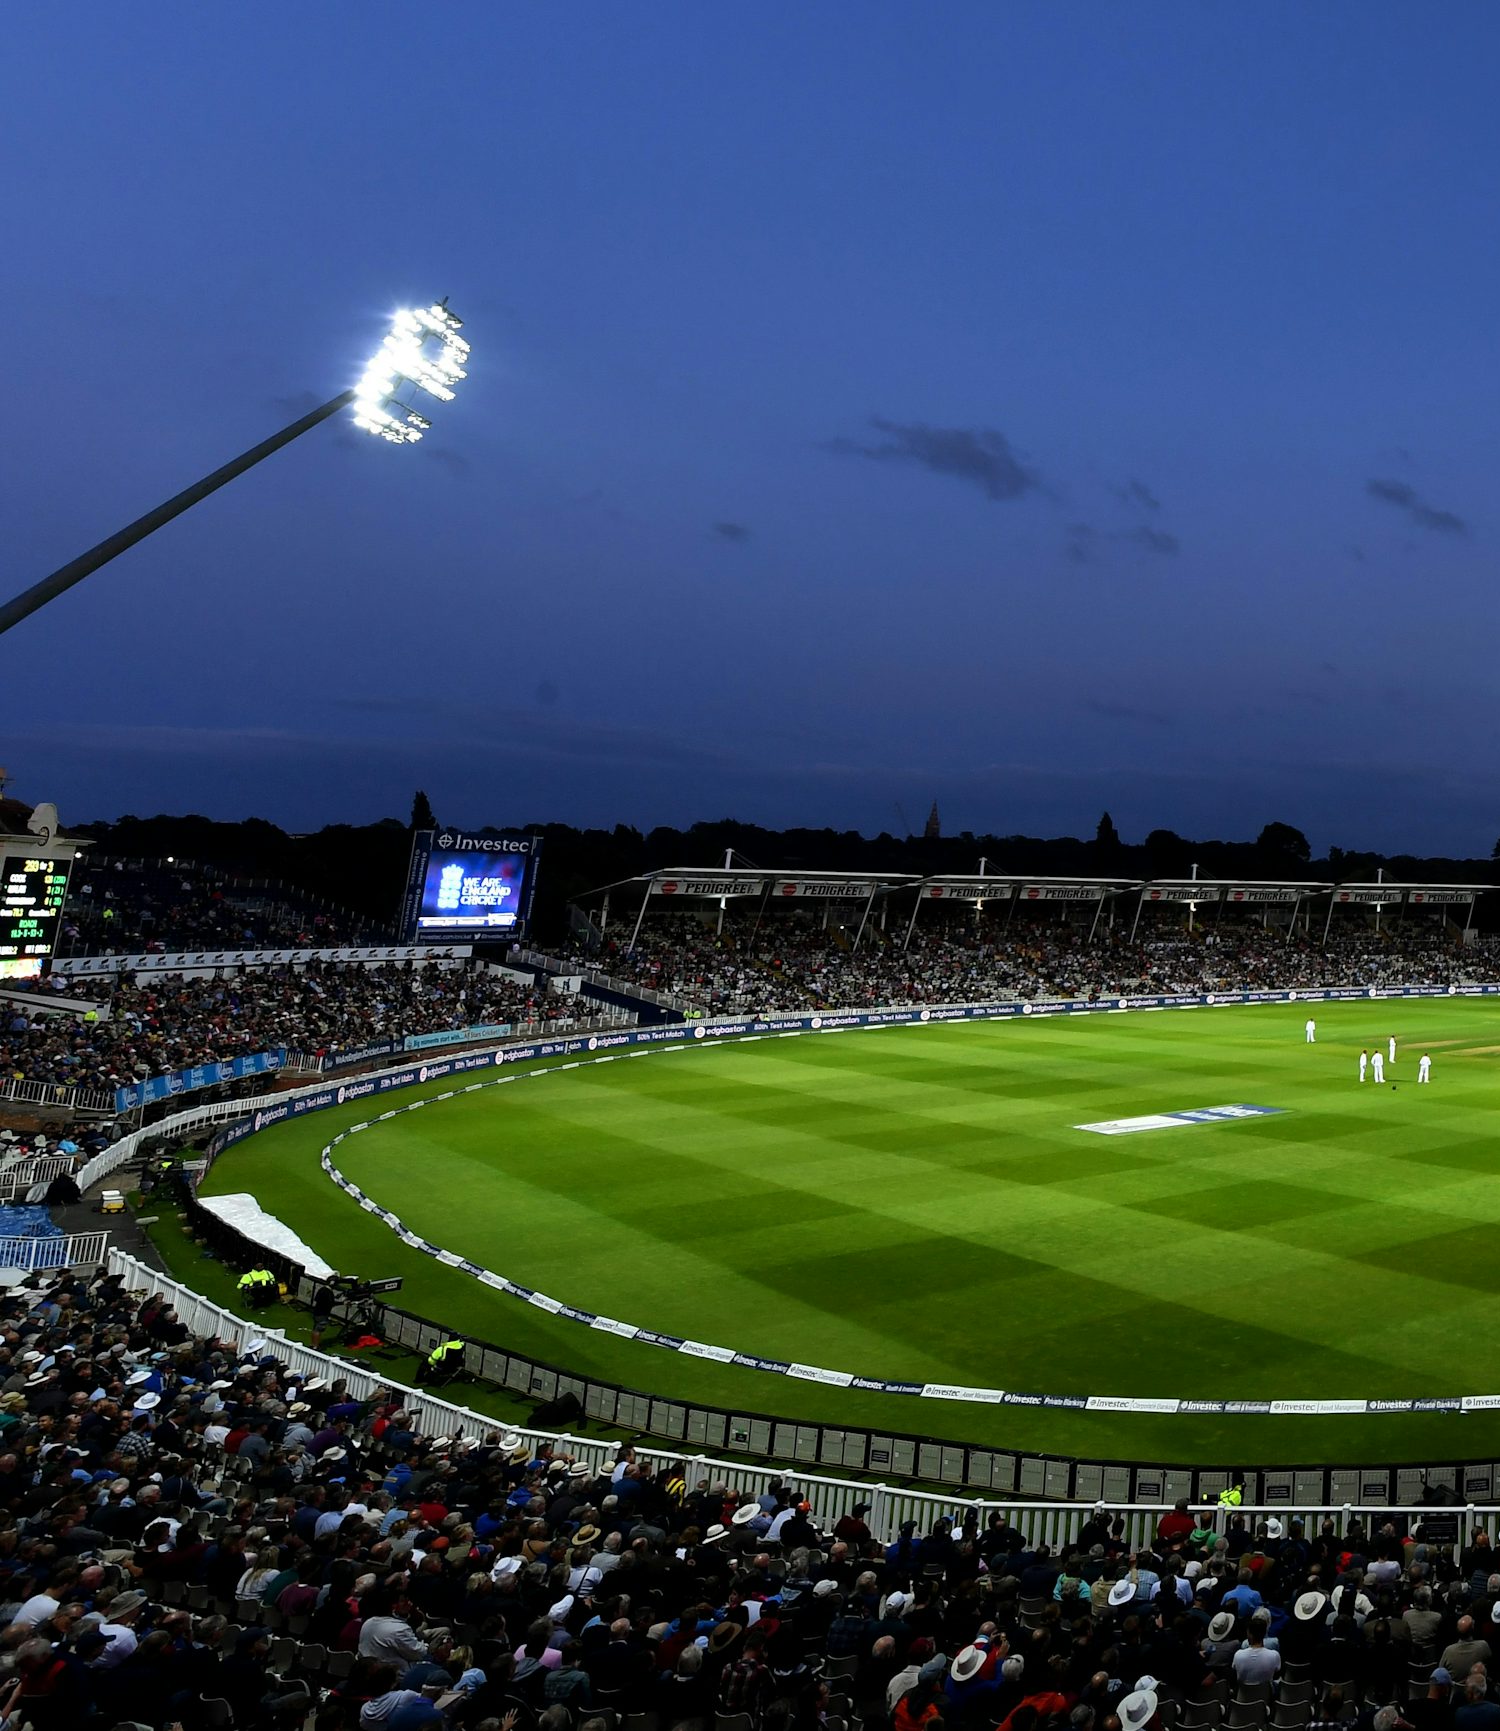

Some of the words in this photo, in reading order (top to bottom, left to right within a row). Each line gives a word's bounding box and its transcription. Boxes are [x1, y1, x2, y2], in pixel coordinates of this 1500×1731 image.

[455, 834, 529, 852] Investec
[464, 877, 480, 888] WE
[481, 877, 502, 888] ARE
[461, 886, 511, 896] ENGLAND
[684, 883, 747, 894] PEDIGREE
[802, 885, 859, 896] PEDIGREE
[949, 887, 1001, 898] PEDIGREE
[1044, 889, 1091, 899] PEDIGREE
[460, 895, 503, 906] CRICKET
[1032, 1002, 1066, 1012] edgbaston
[930, 1009, 966, 1019] edgbaston
[822, 1016, 860, 1027] edgbaston
[706, 1024, 747, 1037] edgbaston
[597, 1036, 630, 1048] edgbaston
[504, 1049, 535, 1062] edgbaston
[796, 1365, 818, 1379] Investec
[859, 1378, 884, 1390] Investec
[931, 1387, 960, 1398] Investec
[1010, 1394, 1042, 1405] Investec
[1096, 1398, 1130, 1408] Investec
[1377, 1399, 1412, 1410] Investec
[1415, 1400, 1436, 1409] Private
[1188, 1401, 1223, 1411] Investec
[1280, 1402, 1316, 1412] Investec
